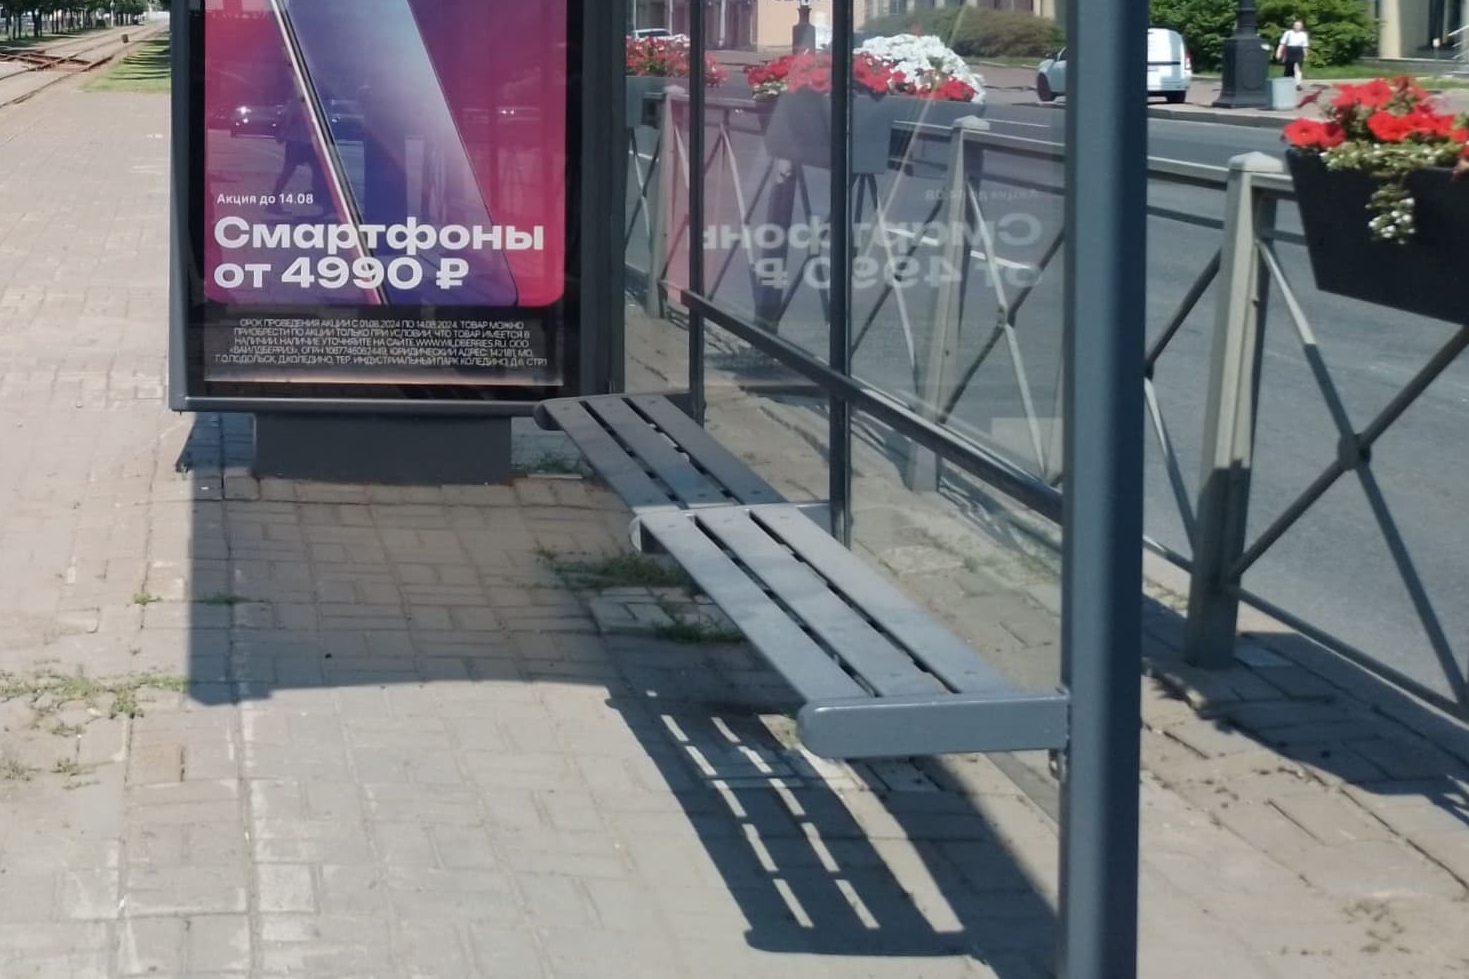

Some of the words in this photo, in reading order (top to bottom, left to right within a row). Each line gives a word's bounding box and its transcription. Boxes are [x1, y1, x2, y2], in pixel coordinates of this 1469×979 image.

[217, 193, 256, 207] Акция
[259, 195, 276, 207] до
[278, 193, 314, 205] 14.08
[214, 216, 544, 256] Смартфоны
[214, 263, 272, 289] от
[281, 256, 424, 290] 4990
[436, 257, 470, 290] ₽
